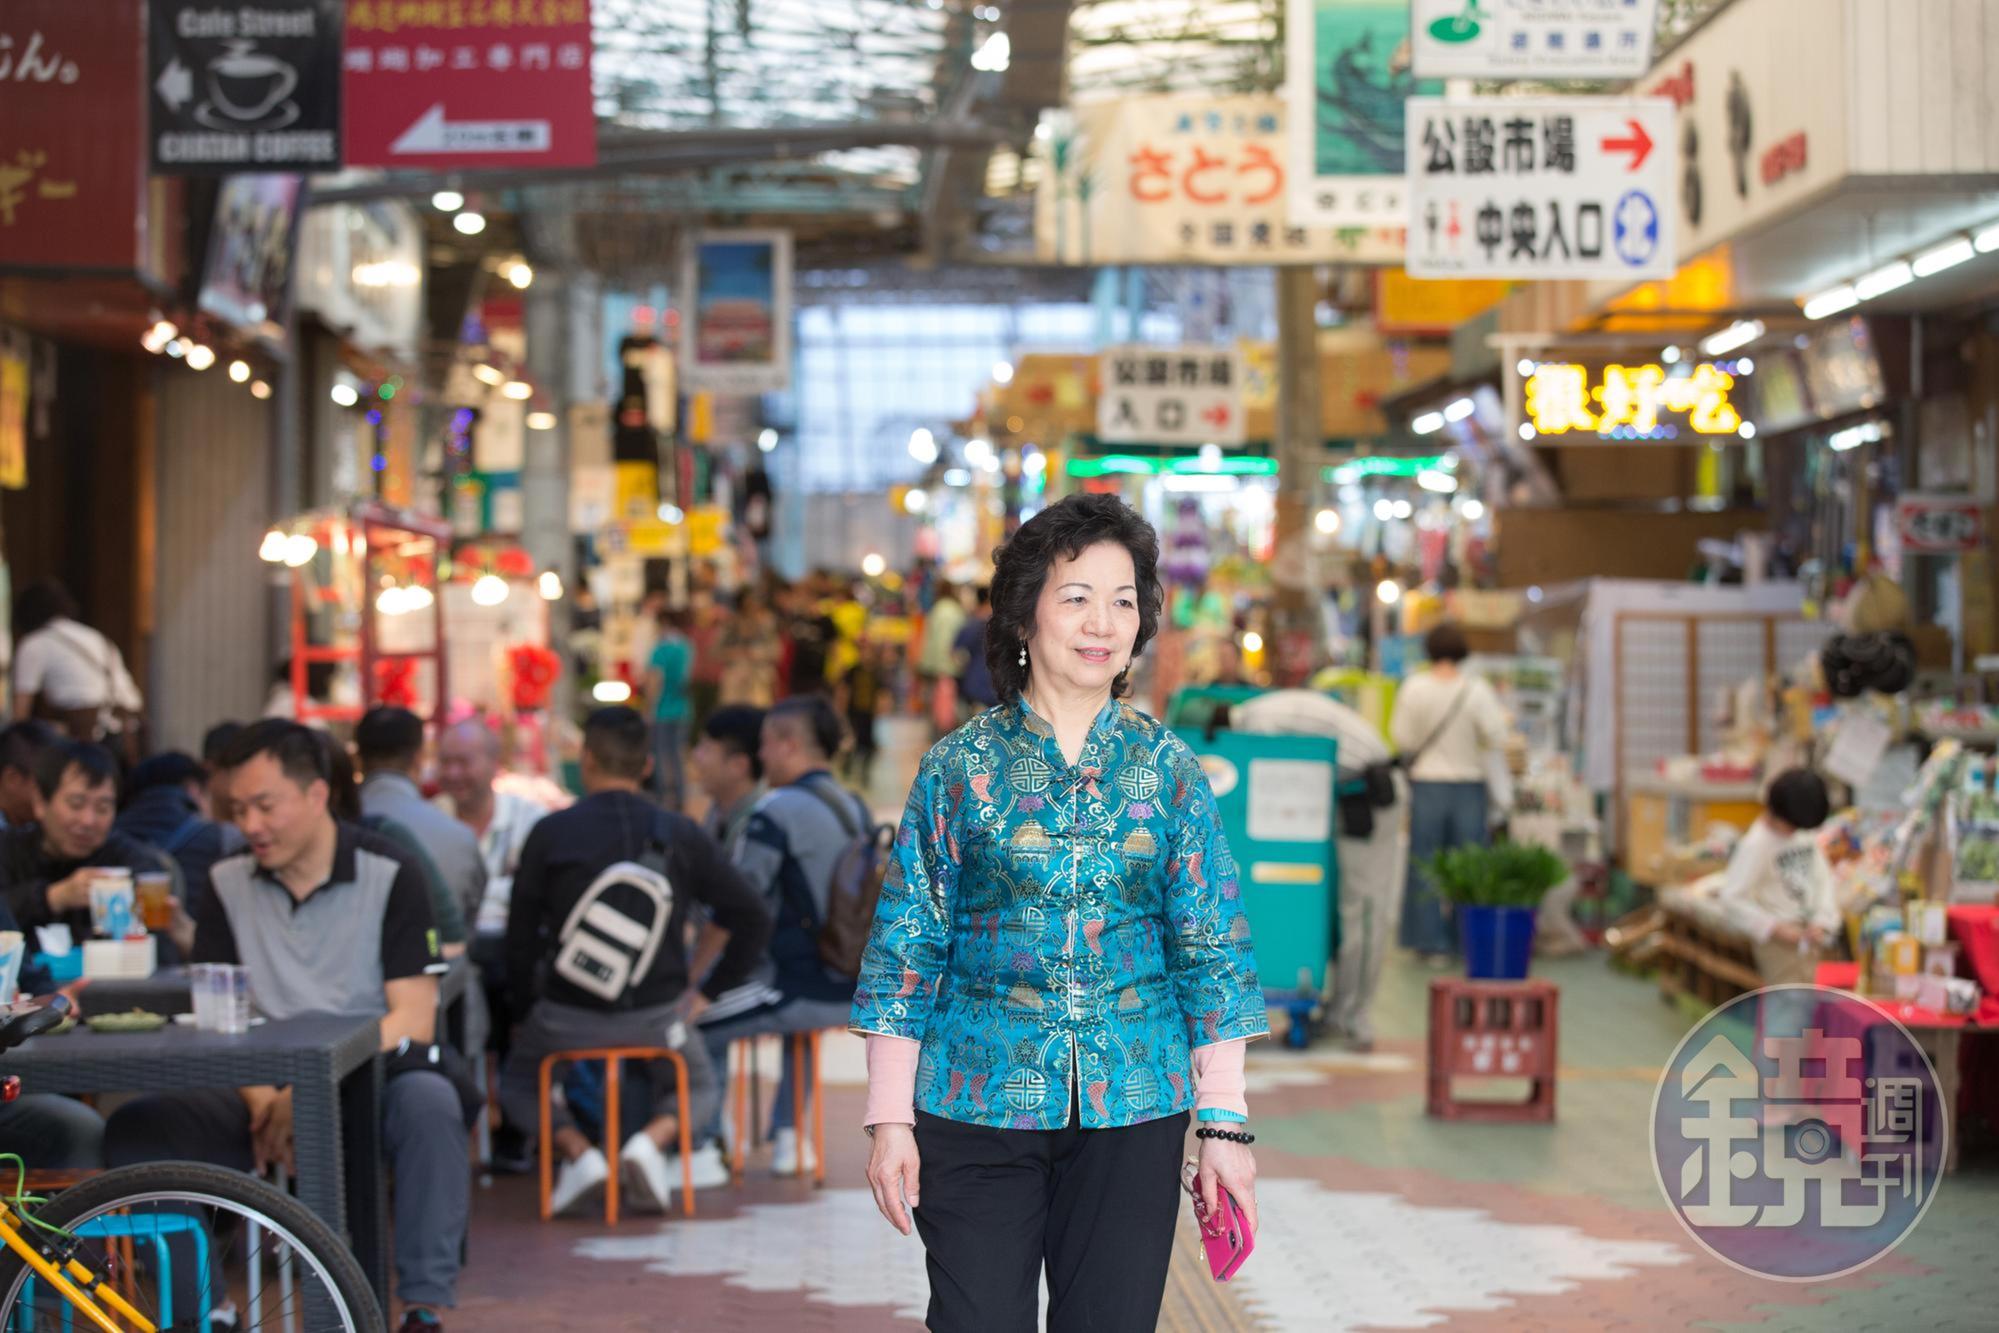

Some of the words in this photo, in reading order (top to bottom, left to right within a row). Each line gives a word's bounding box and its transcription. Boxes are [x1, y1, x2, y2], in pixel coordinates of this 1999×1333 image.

[239, 7, 315, 38] Street
[253, 129, 336, 162] COFFEE
[1423, 114, 1576, 174] 公設市場
[1128, 145, 1285, 205] さとう
[1476, 199, 1602, 259] 中央入口
[1112, 357, 1232, 387] 公設市場
[1112, 399, 1187, 431] 入口
